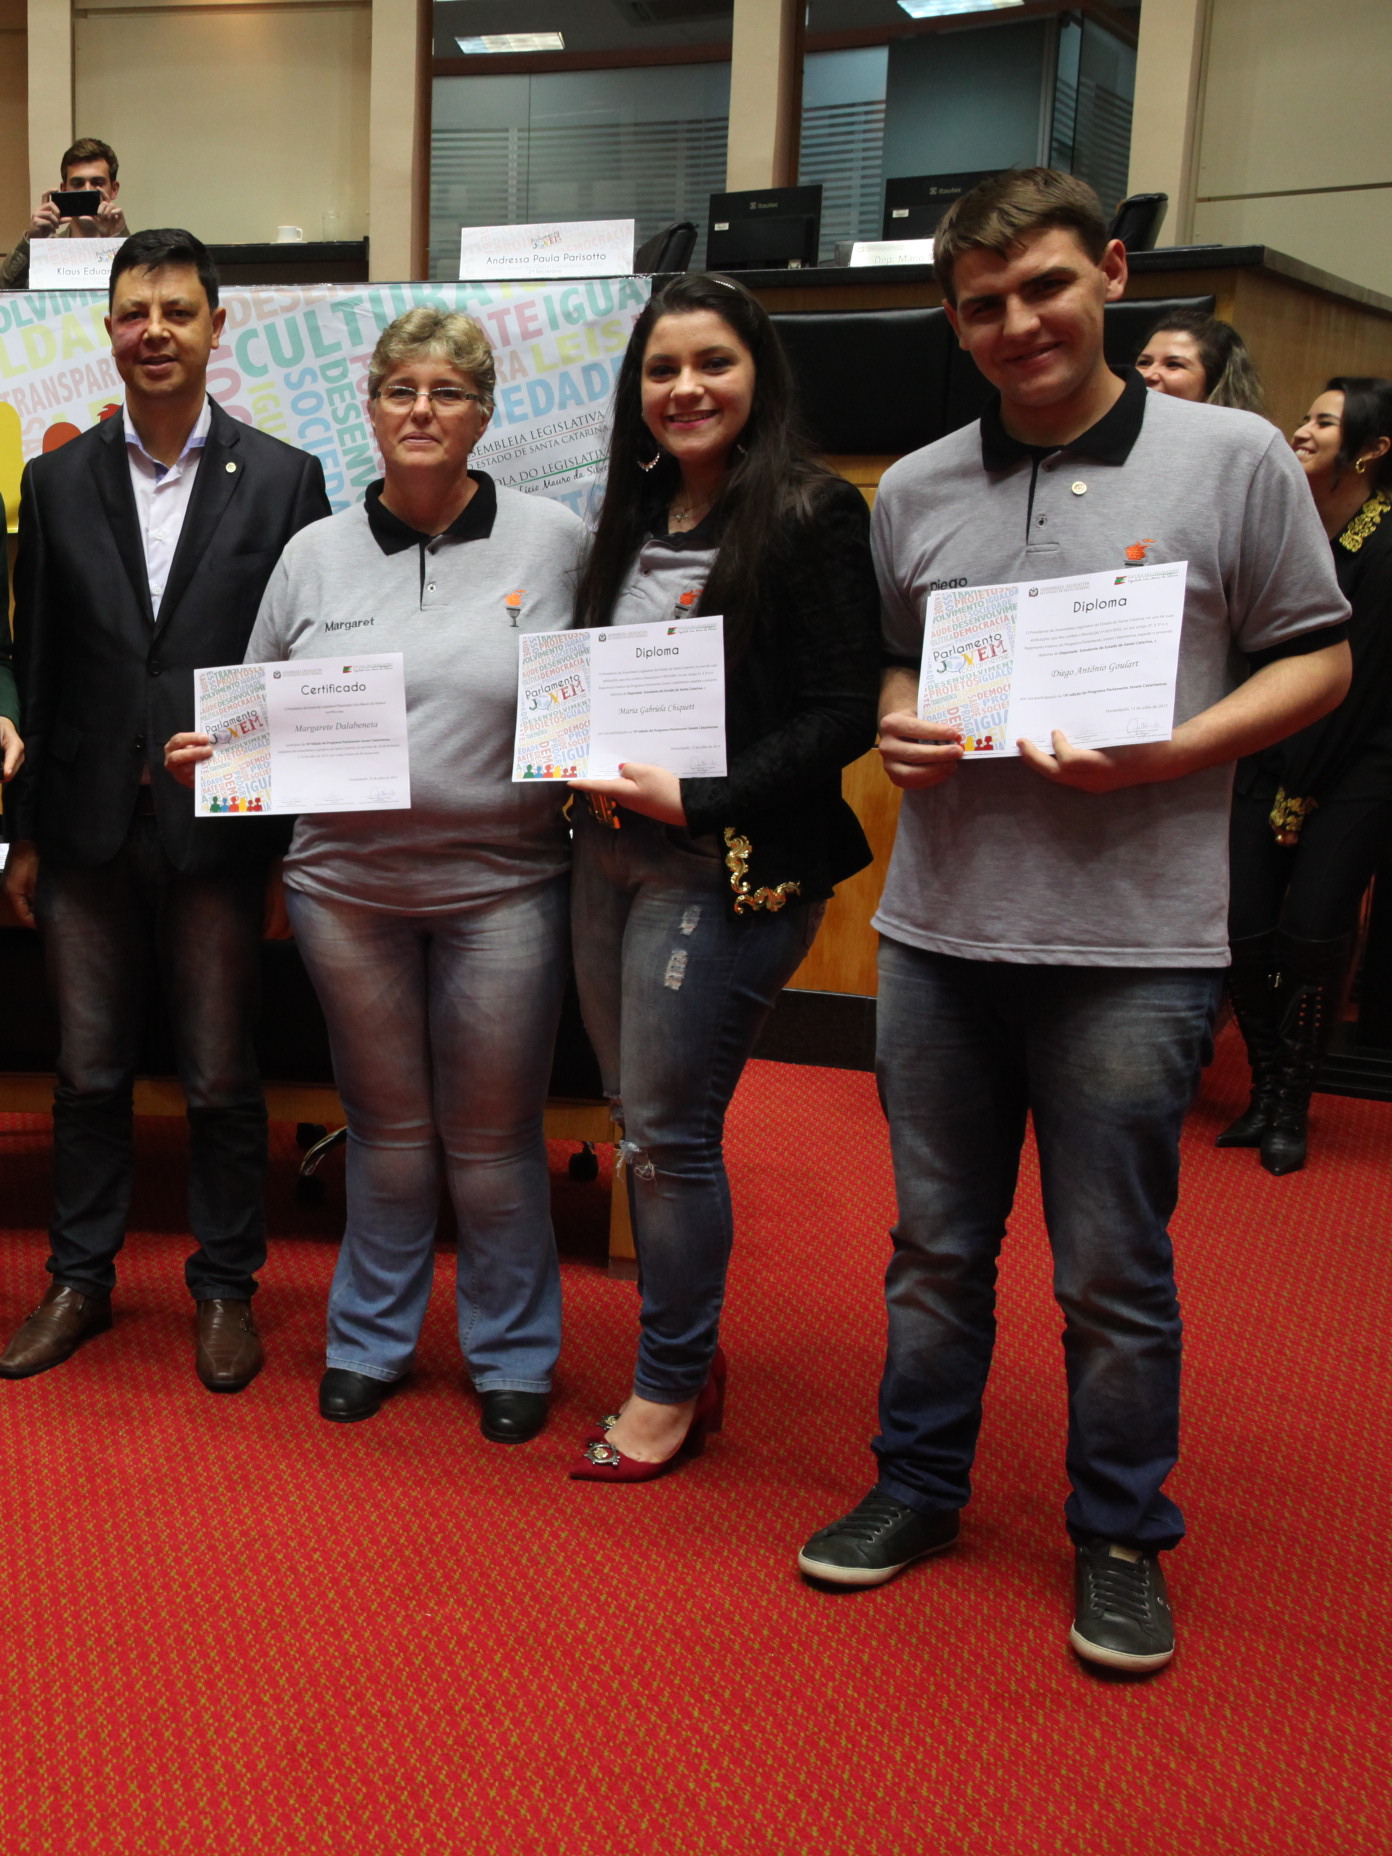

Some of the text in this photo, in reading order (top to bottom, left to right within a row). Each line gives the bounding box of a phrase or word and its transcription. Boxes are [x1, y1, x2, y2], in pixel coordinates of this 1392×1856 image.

[486, 252, 607, 265] Andressa Paula Parisotto
[57, 267, 81, 276] Klaus
[530, 319, 629, 375] LEIS
[530, 410, 605, 441] LEGISLATIVA
[476, 452, 512, 470] ESTADO
[514, 447, 527, 458] DE
[529, 440, 560, 454] SANTA
[561, 424, 609, 444] CATARINA
[519, 468, 539, 482] DO
[543, 476, 571, 490] Mauro
[573, 468, 585, 480] da
[1073, 597, 1127, 613] Diploma
[324, 617, 375, 633] Margaret
[953, 615, 1010, 639] DEMOCRACIA
[636, 646, 679, 658] Diploma
[933, 633, 1002, 662] Parlamento
[540, 657, 585, 680] DEMOCRACIA
[1051, 669, 1074, 679] Diego
[1108, 660, 1139, 672] Goulart
[301, 682, 367, 696] Certificado
[525, 674, 580, 700] Parlamento
[219, 694, 261, 715] DEMOCRACIA
[618, 706, 639, 715] Maria
[640, 705, 666, 714] Gabriela
[205, 710, 258, 734] Parlamento
[295, 722, 334, 733] Margarete
